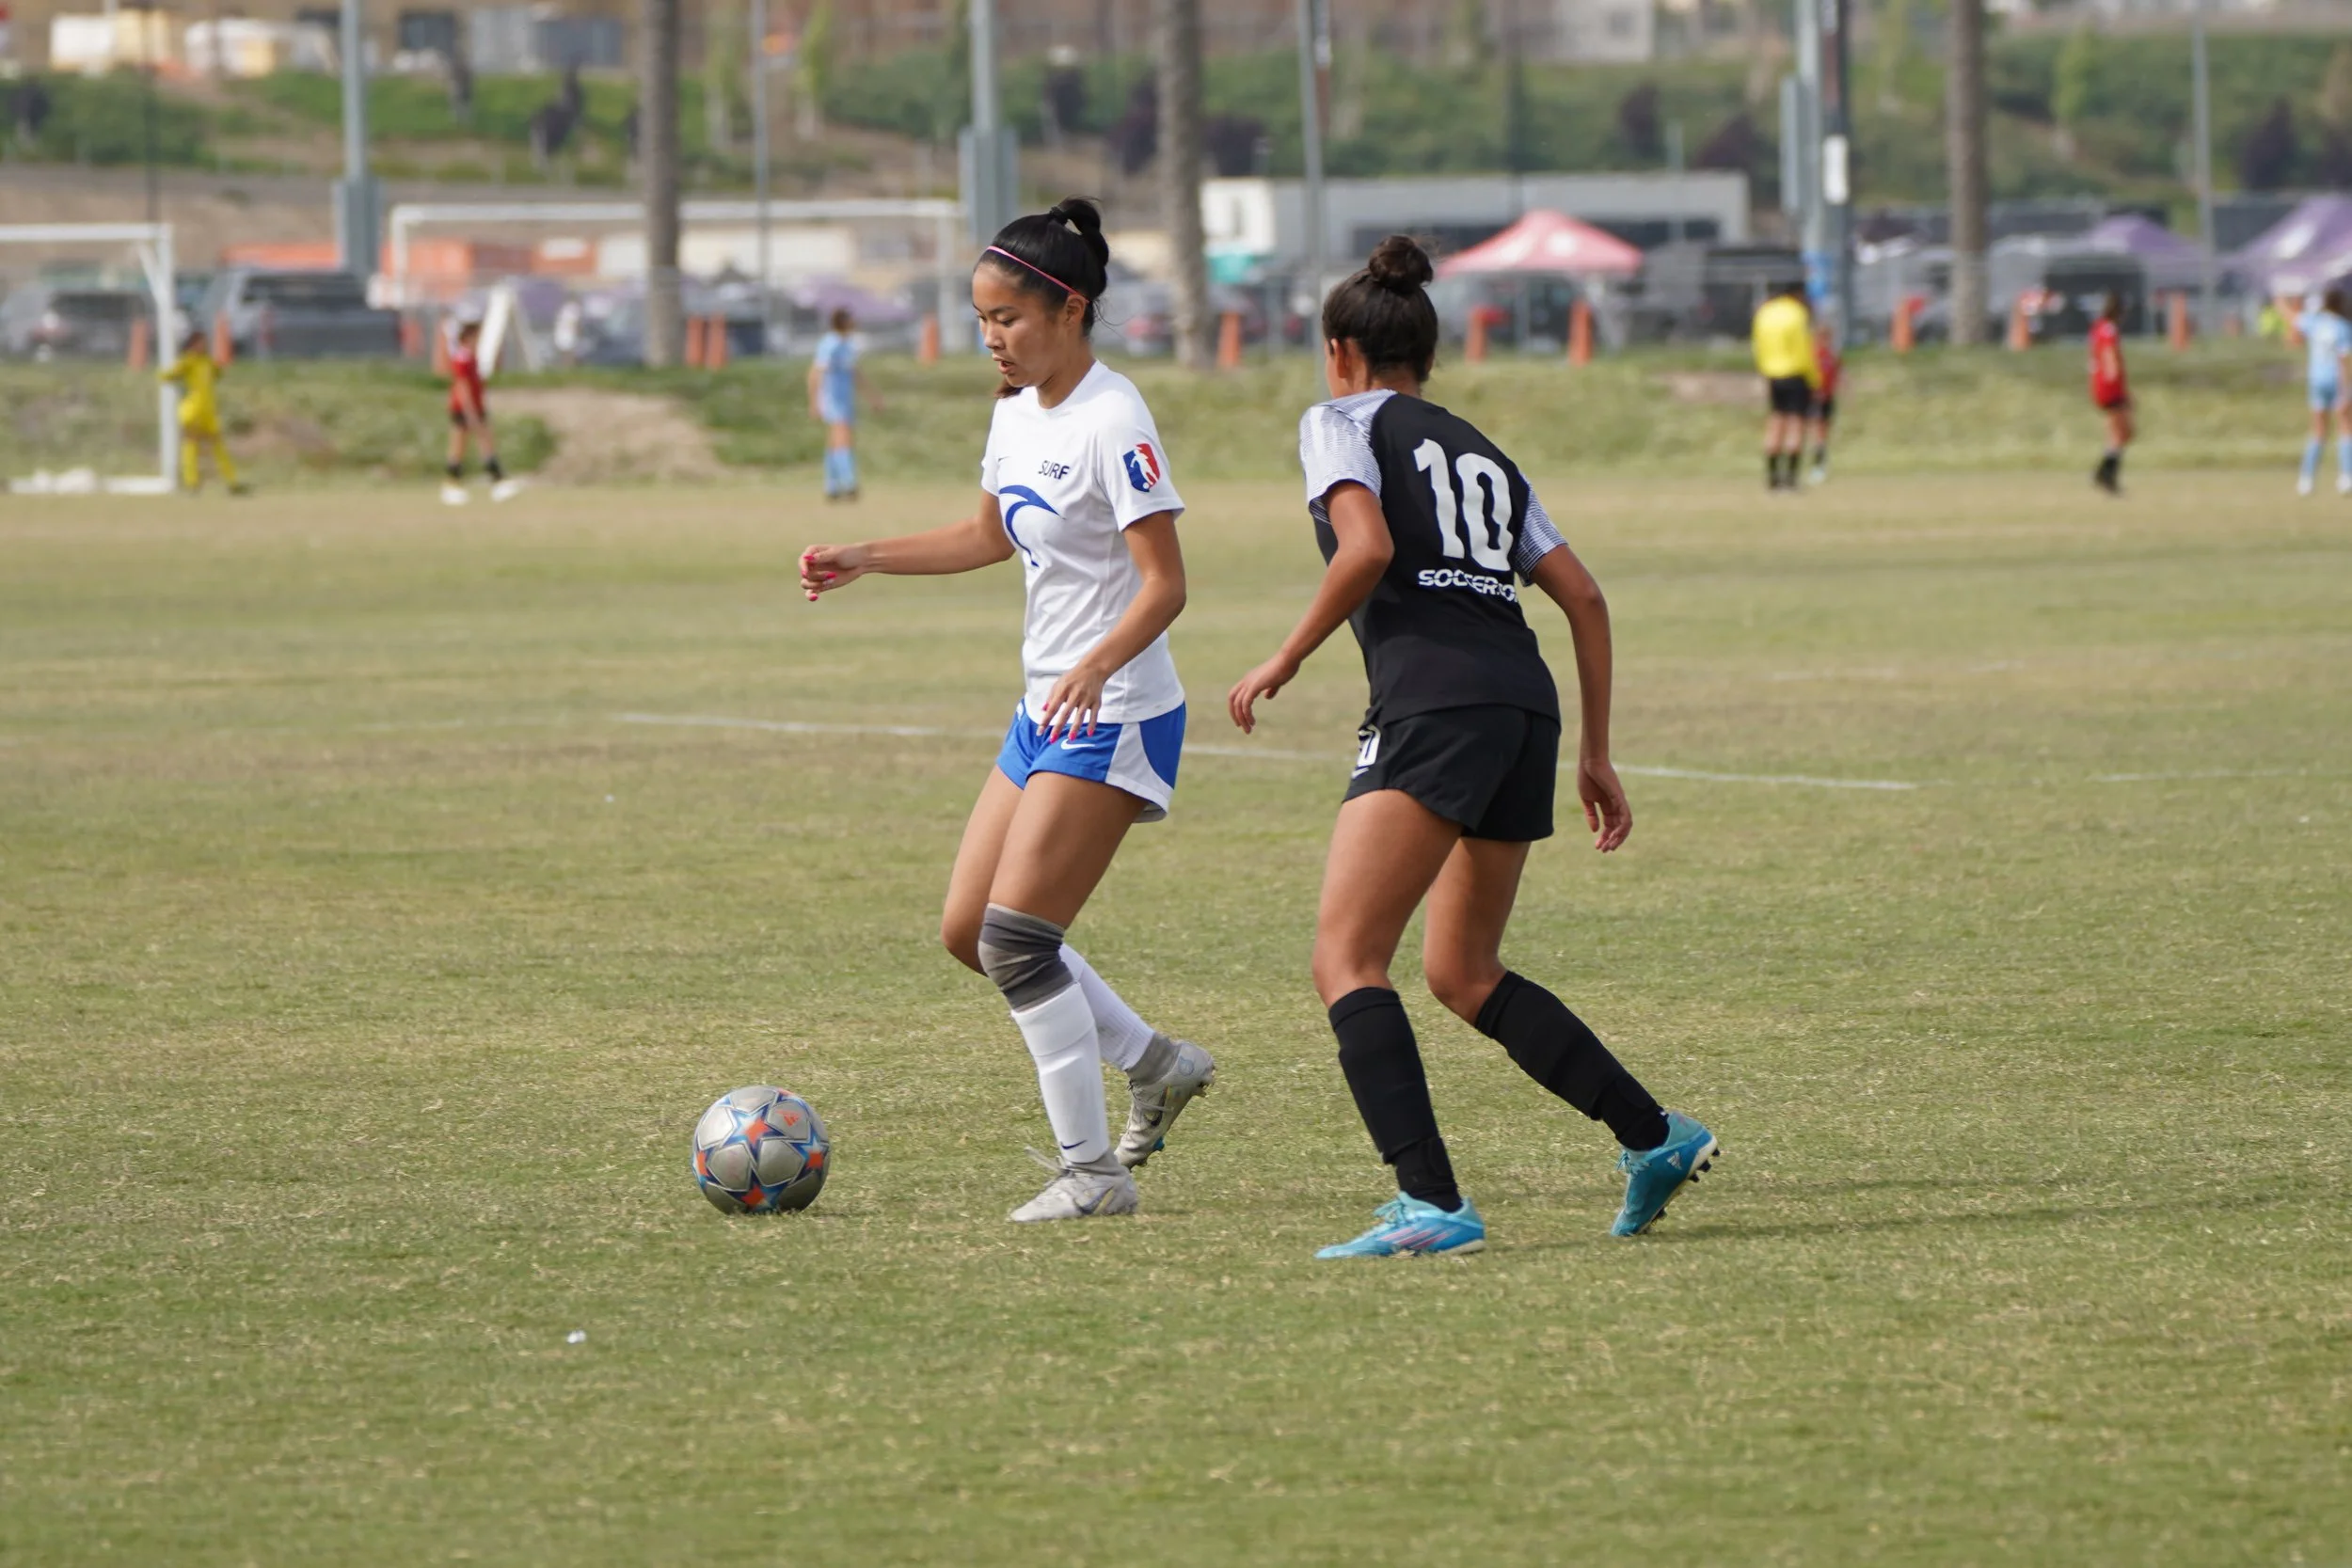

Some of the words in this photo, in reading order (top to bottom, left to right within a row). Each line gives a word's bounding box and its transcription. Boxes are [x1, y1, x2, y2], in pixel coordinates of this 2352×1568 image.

[1038, 459, 1071, 480] SURF
[1413, 438, 1514, 571] 10
[1418, 568, 1518, 603] SOCCER.O
